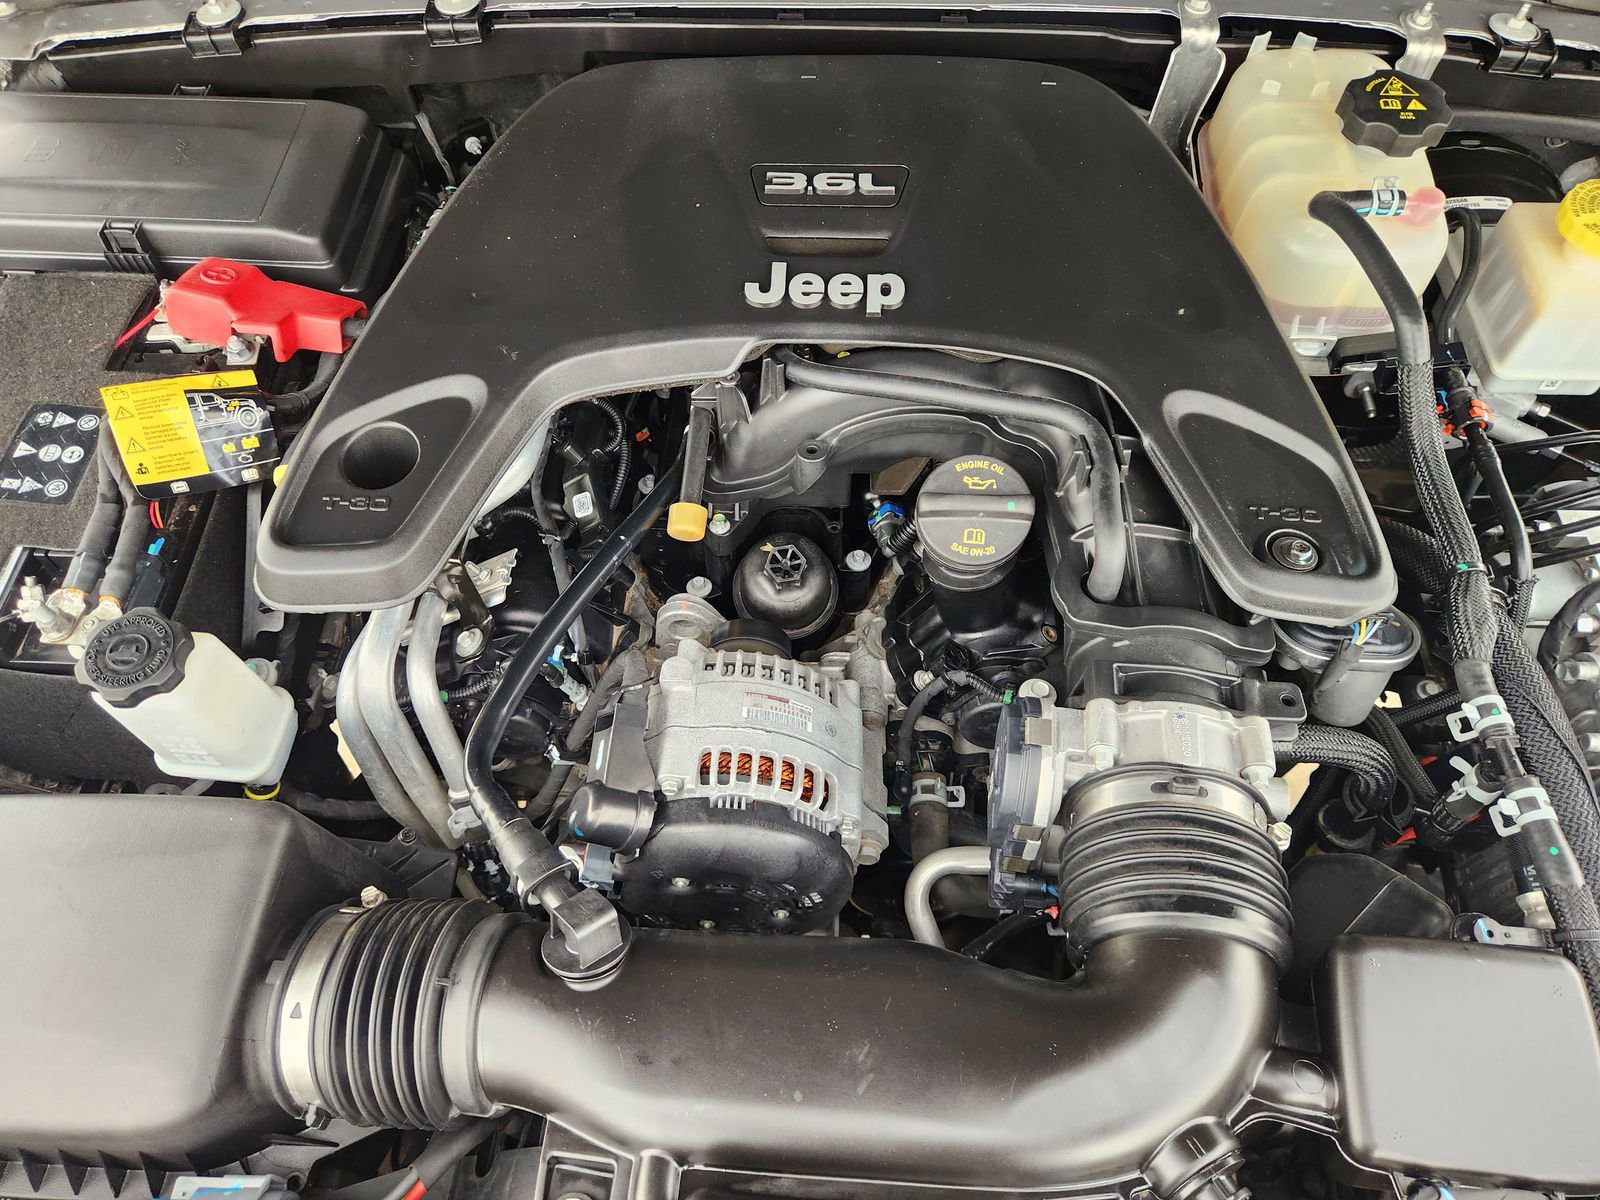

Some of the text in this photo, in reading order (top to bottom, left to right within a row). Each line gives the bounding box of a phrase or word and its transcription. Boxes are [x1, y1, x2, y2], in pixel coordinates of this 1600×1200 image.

[764, 171, 896, 196] 3.6L
[744, 261, 906, 318] Jeep
[954, 460, 1006, 475] ENGINE OIL
[322, 495, 390, 512] T-30
[950, 542, 996, 556] SAE 0W-20
[102, 616, 167, 637] USE APPROVED
[86, 648, 168, 686] POWER STEERING FLUID
